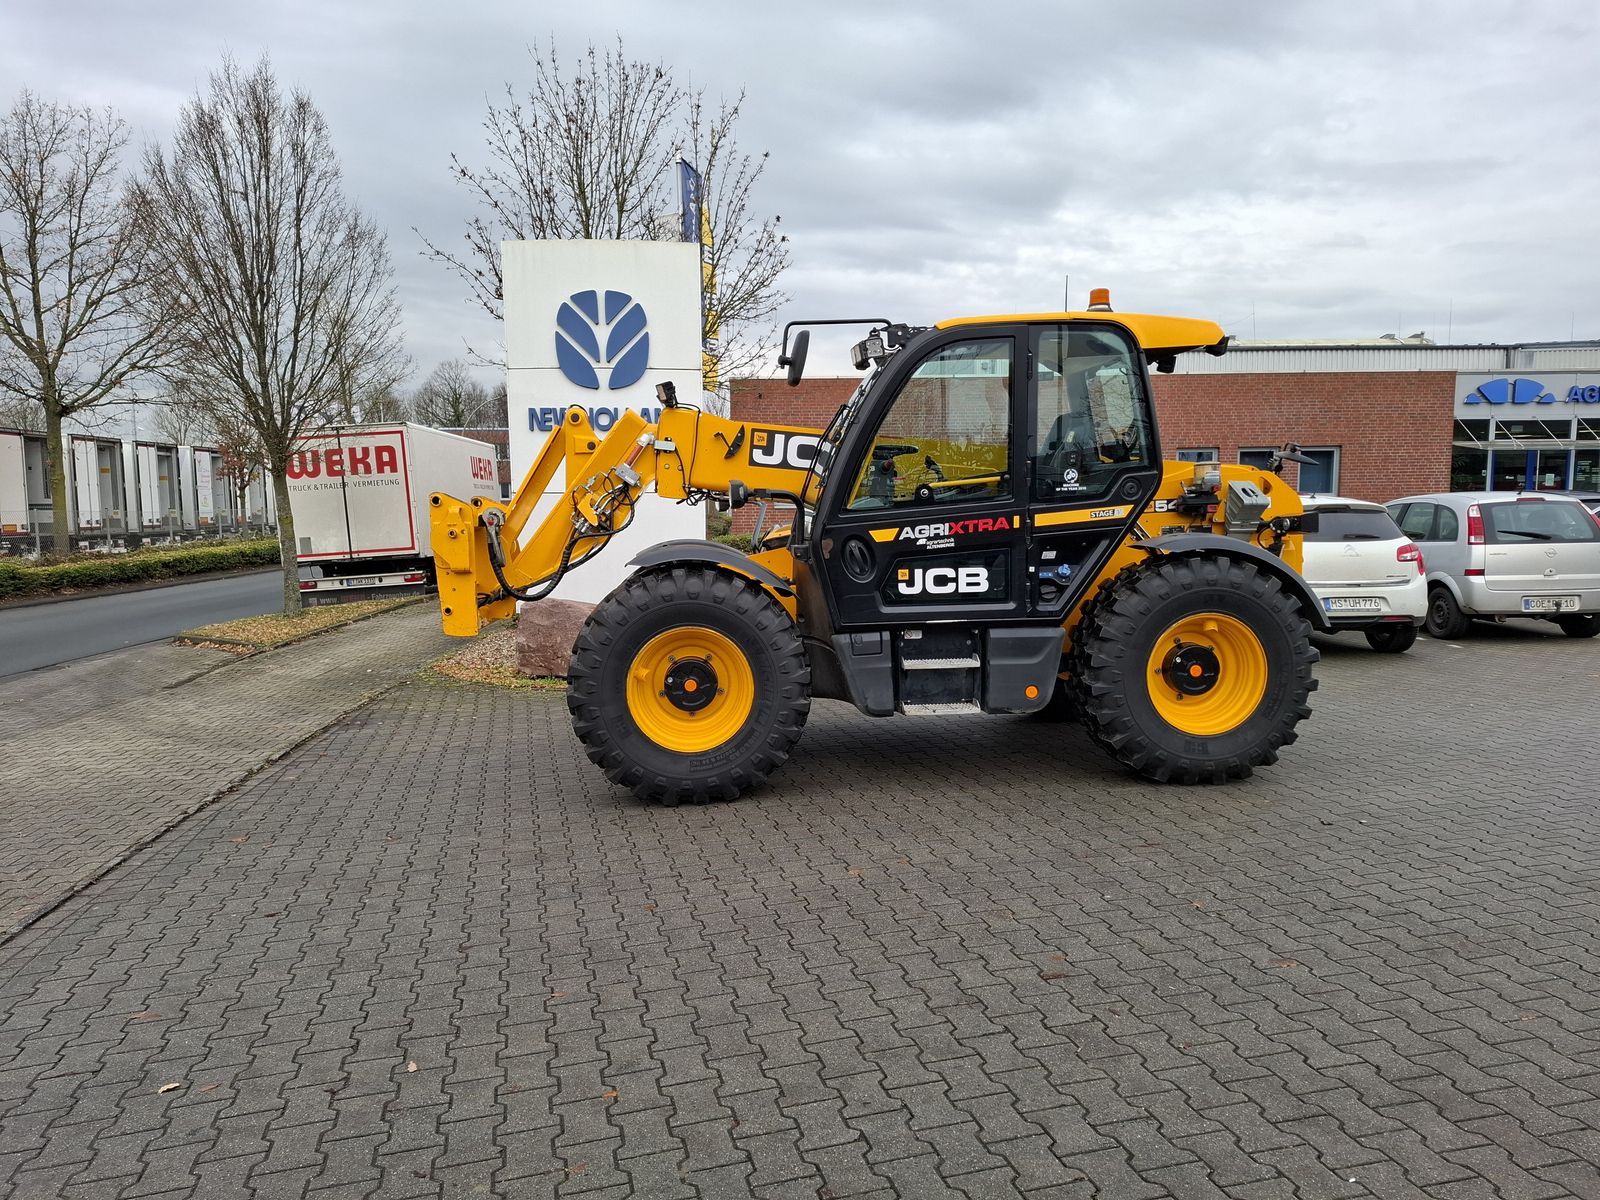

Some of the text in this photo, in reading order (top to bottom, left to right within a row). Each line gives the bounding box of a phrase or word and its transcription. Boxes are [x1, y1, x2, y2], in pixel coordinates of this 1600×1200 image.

[1566, 384, 1600, 403] AG
[287, 445, 398, 480] WEKA
[753, 433, 831, 474] JC
[470, 456, 493, 481] WEKA
[320, 481, 349, 490] TRAILER
[353, 479, 399, 488] VERMIETUNG
[1091, 509, 1114, 518] STAGE
[898, 567, 989, 595] JCB
